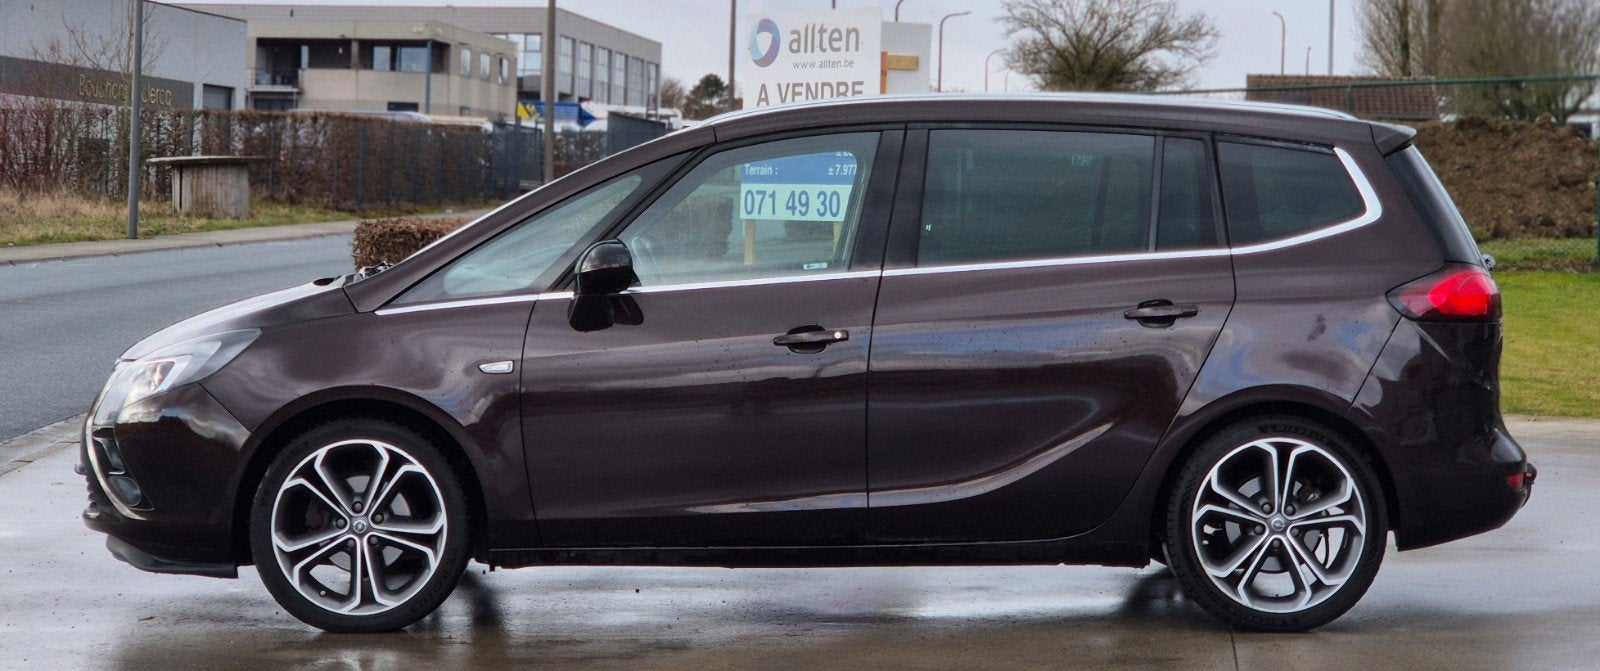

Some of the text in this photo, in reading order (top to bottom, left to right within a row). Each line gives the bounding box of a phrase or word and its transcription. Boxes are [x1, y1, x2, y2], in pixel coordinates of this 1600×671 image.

[788, 24, 860, 54] allten
[792, 59, 855, 69] www.allten.be
[756, 83, 770, 107] A
[744, 163, 773, 175] Terrain
[744, 190, 841, 217] 071 49 30
